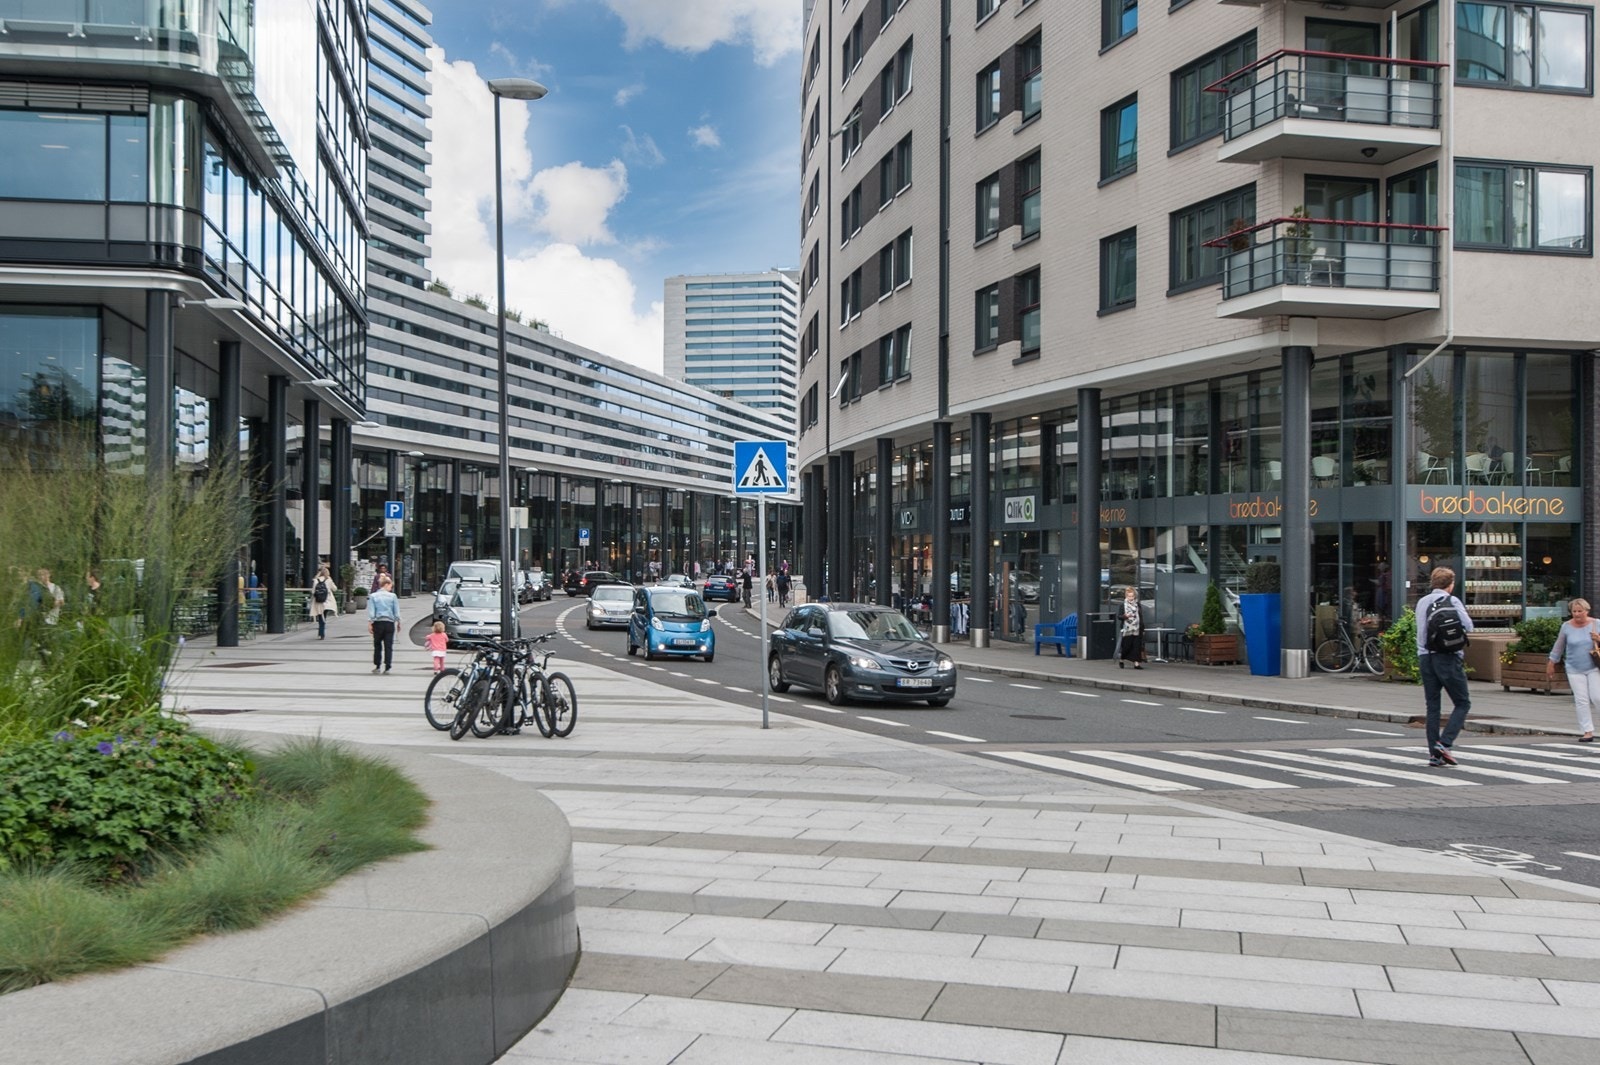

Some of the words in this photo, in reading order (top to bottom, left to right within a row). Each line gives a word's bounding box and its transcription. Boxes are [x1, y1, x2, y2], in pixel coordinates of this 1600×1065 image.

[390, 503, 400, 517] P
[1006, 501, 1023, 519] Qlik
[1230, 496, 1318, 518] brødbake
[1420, 489, 1565, 515] brødbakerne
[581, 529, 588, 538] P
